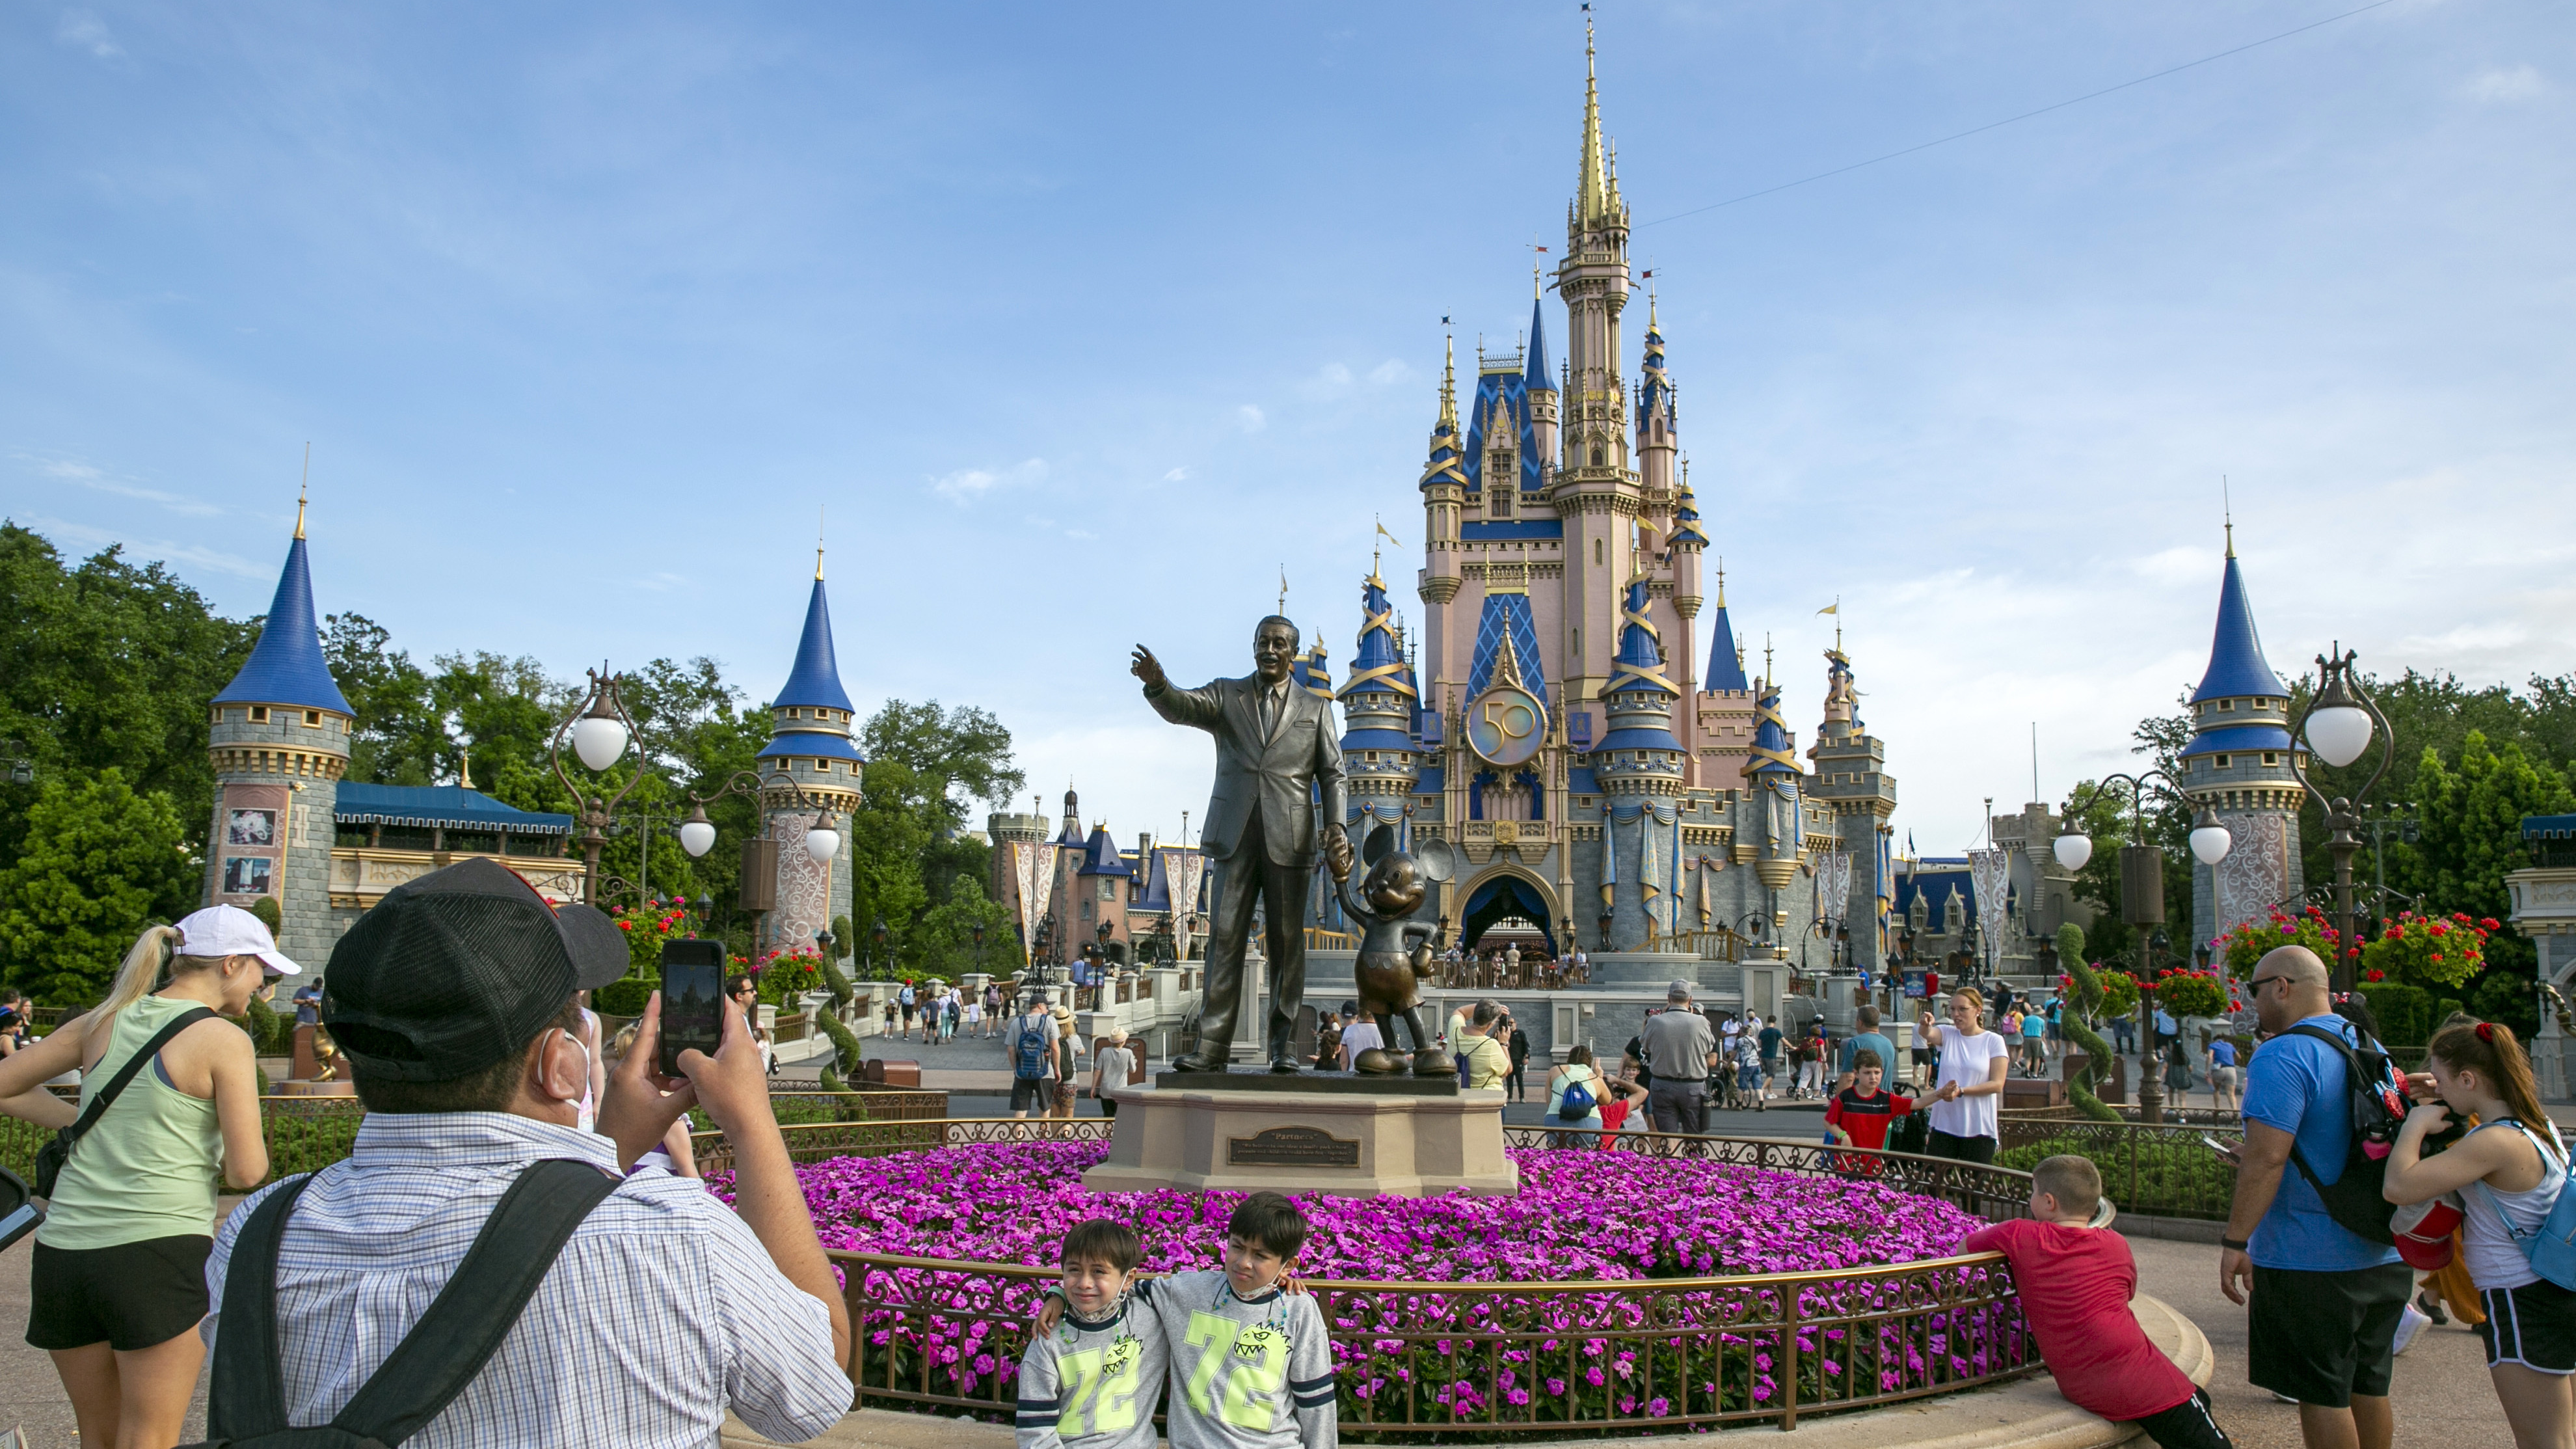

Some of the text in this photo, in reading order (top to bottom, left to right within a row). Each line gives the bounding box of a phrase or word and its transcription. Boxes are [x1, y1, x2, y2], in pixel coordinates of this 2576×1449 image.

[1485, 701, 1536, 757] 50
[784, 919, 811, 947] 50
[1056, 1340, 1141, 1435] 72
[1184, 1310, 1288, 1432] 72
